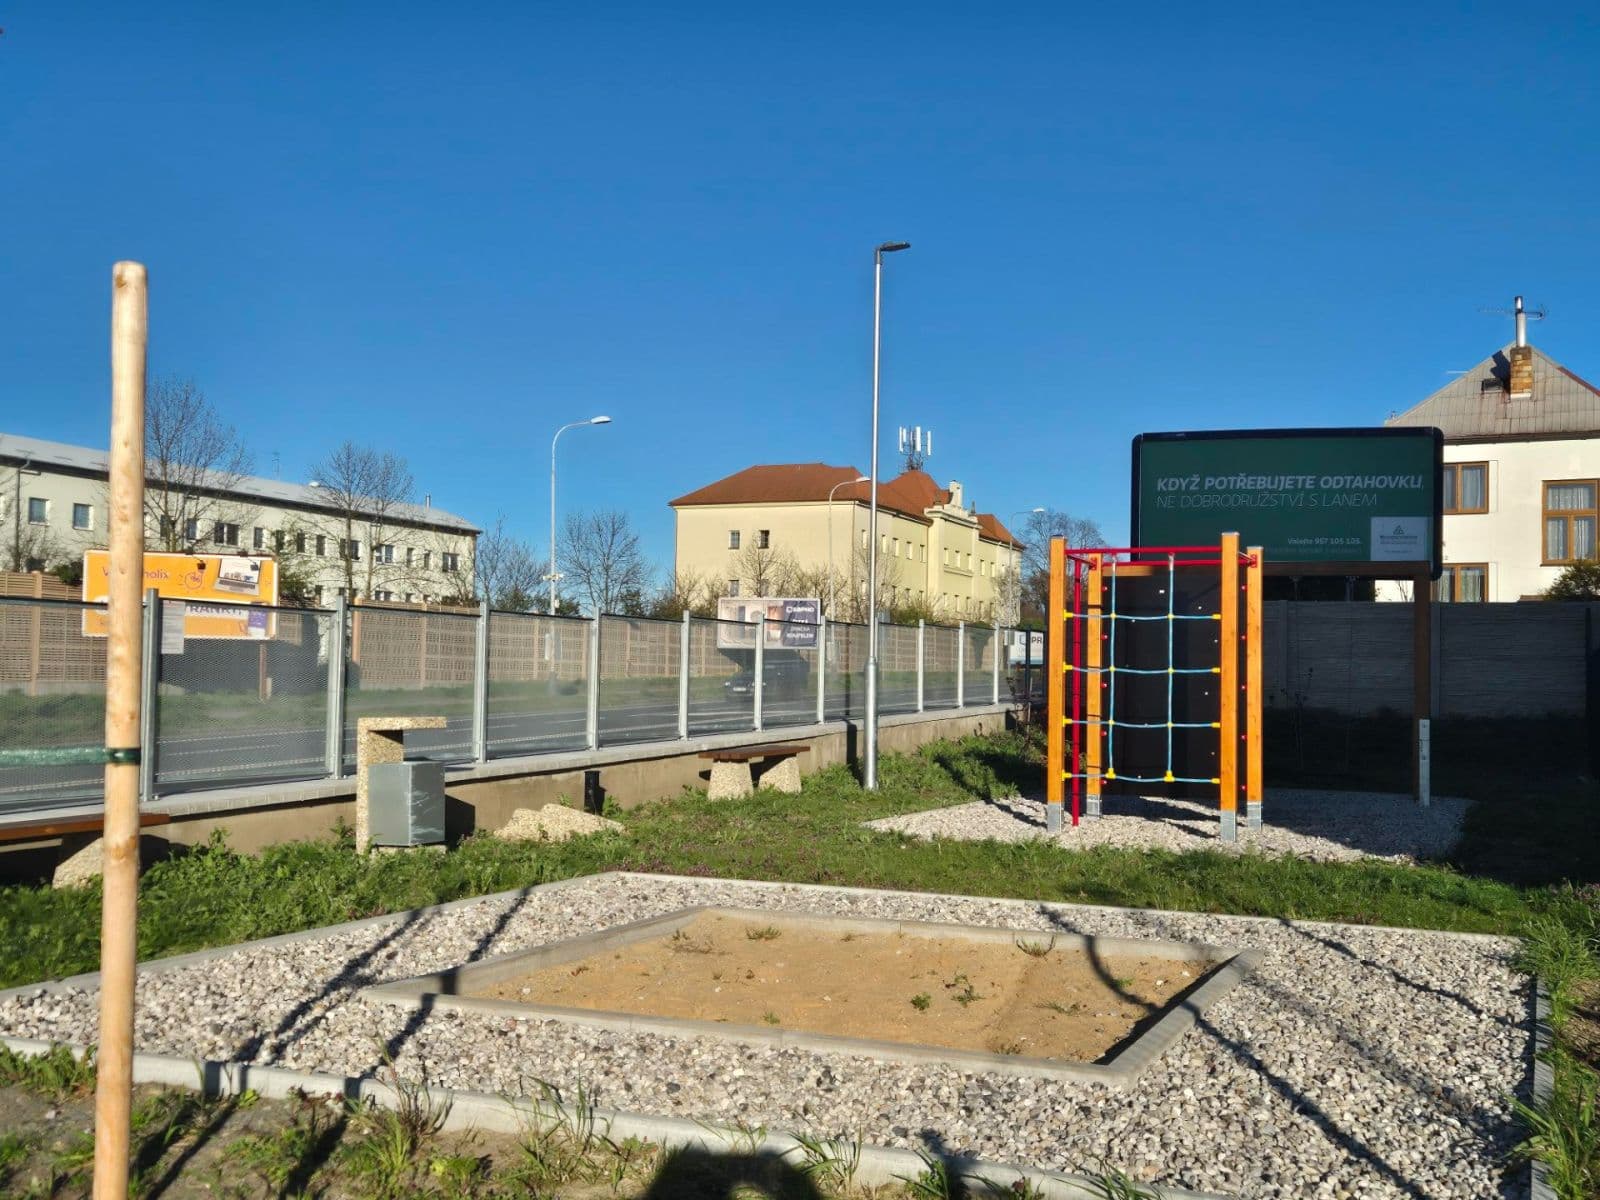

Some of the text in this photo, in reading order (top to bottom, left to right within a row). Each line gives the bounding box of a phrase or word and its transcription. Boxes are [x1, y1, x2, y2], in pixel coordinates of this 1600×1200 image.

[1157, 474, 1201, 491] KDYŽ
[1204, 473, 1316, 491] POTŘEBUJETE
[1157, 491, 1378, 507] NE DOBRODRUŽSTVÍ S LANEM
